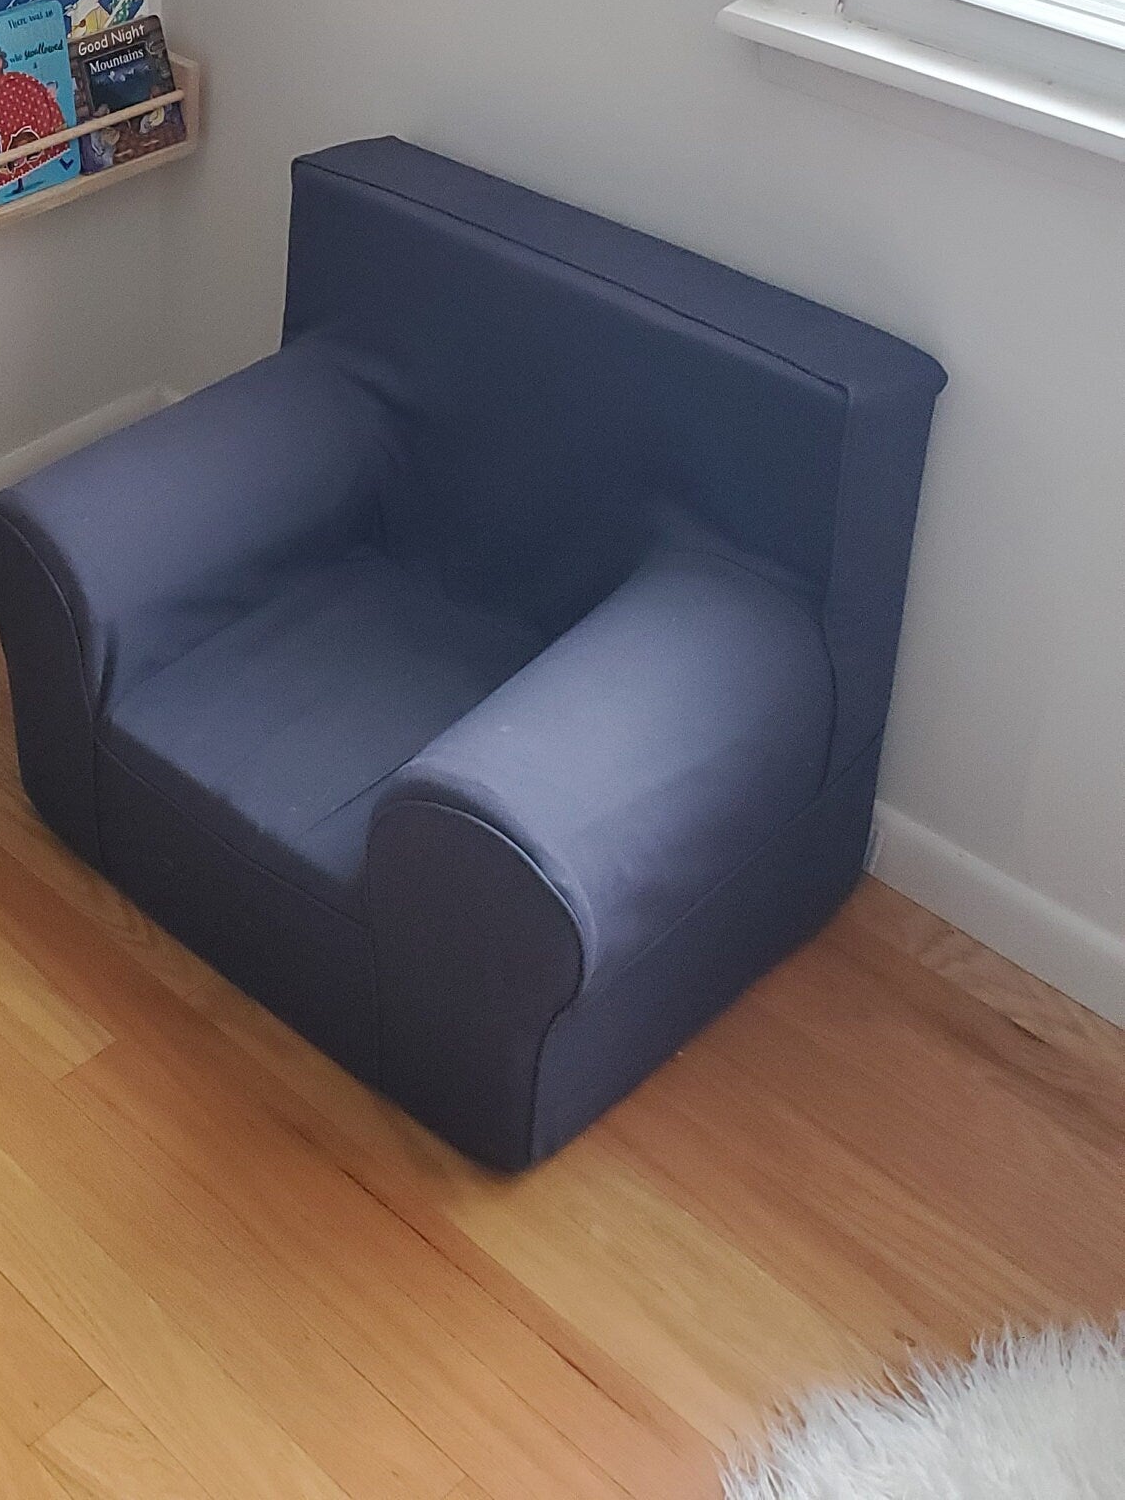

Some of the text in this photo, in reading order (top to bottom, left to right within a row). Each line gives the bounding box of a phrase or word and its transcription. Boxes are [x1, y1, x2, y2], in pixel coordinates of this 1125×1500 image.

[24, 39, 64, 60] swallowed
[78, 23, 146, 56] Good Night
[88, 47, 145, 76] Mountains
